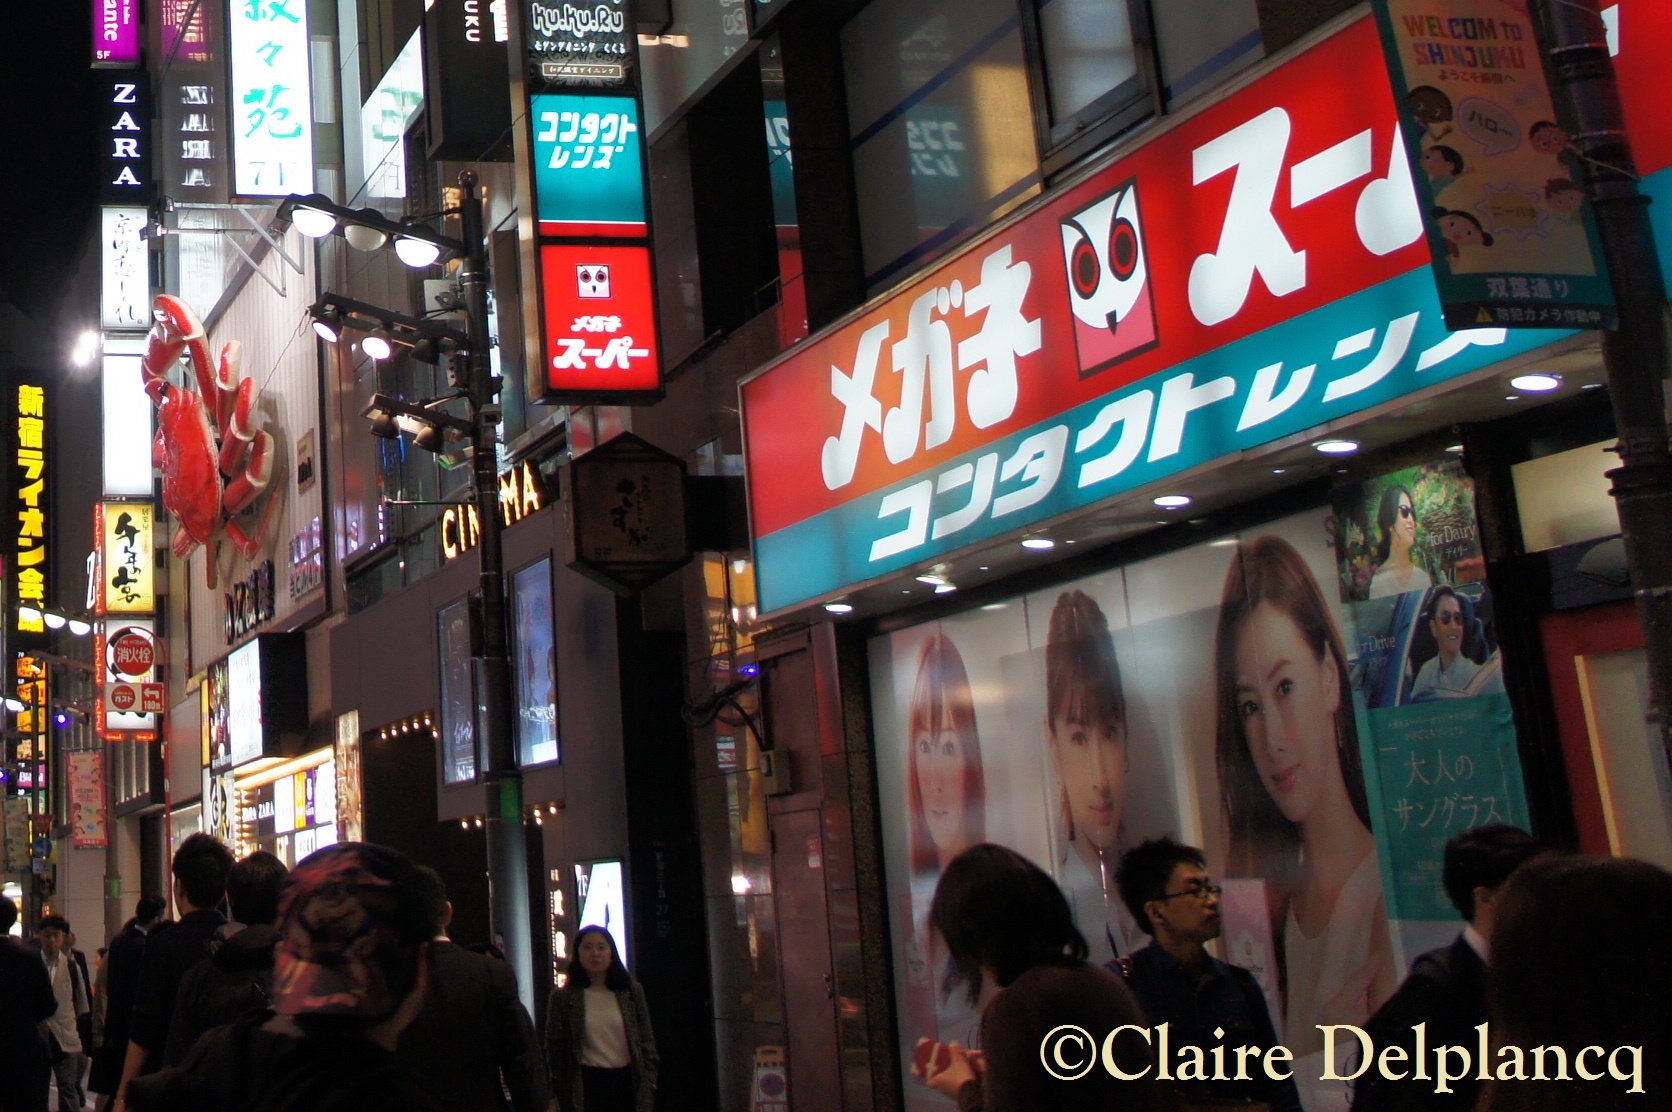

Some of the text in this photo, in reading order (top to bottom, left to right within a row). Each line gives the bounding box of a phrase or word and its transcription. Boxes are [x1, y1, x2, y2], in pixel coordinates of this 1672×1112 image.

[1402, 15, 1497, 41] WELCOM
[96, 51, 110, 59] 5F
[1412, 42, 1526, 70] SHINJUKU
[1438, 69, 1516, 85] ようこそ新宿へ
[112, 83, 142, 186] ZARA
[537, 111, 636, 144] コンタクト
[1468, 110, 1514, 139] ハロー
[547, 144, 625, 171] レンズ
[1487, 278, 1570, 299] 双葉通り
[570, 314, 623, 334] メガネ
[1495, 305, 1602, 325] 防犯カメラ作動中
[553, 335, 650, 370] スーパー
[821, 242, 1042, 491] メガネ
[441, 459, 541, 559] CINMA
[1443, 522, 1477, 545] Dairy
[117, 647, 151, 665] 消火栓
[114, 695, 133, 703] ガスト
[1403, 745, 1476, 787] 大人の
[258, 799, 275, 820] ZARA
[1393, 794, 1504, 832] サングラス
